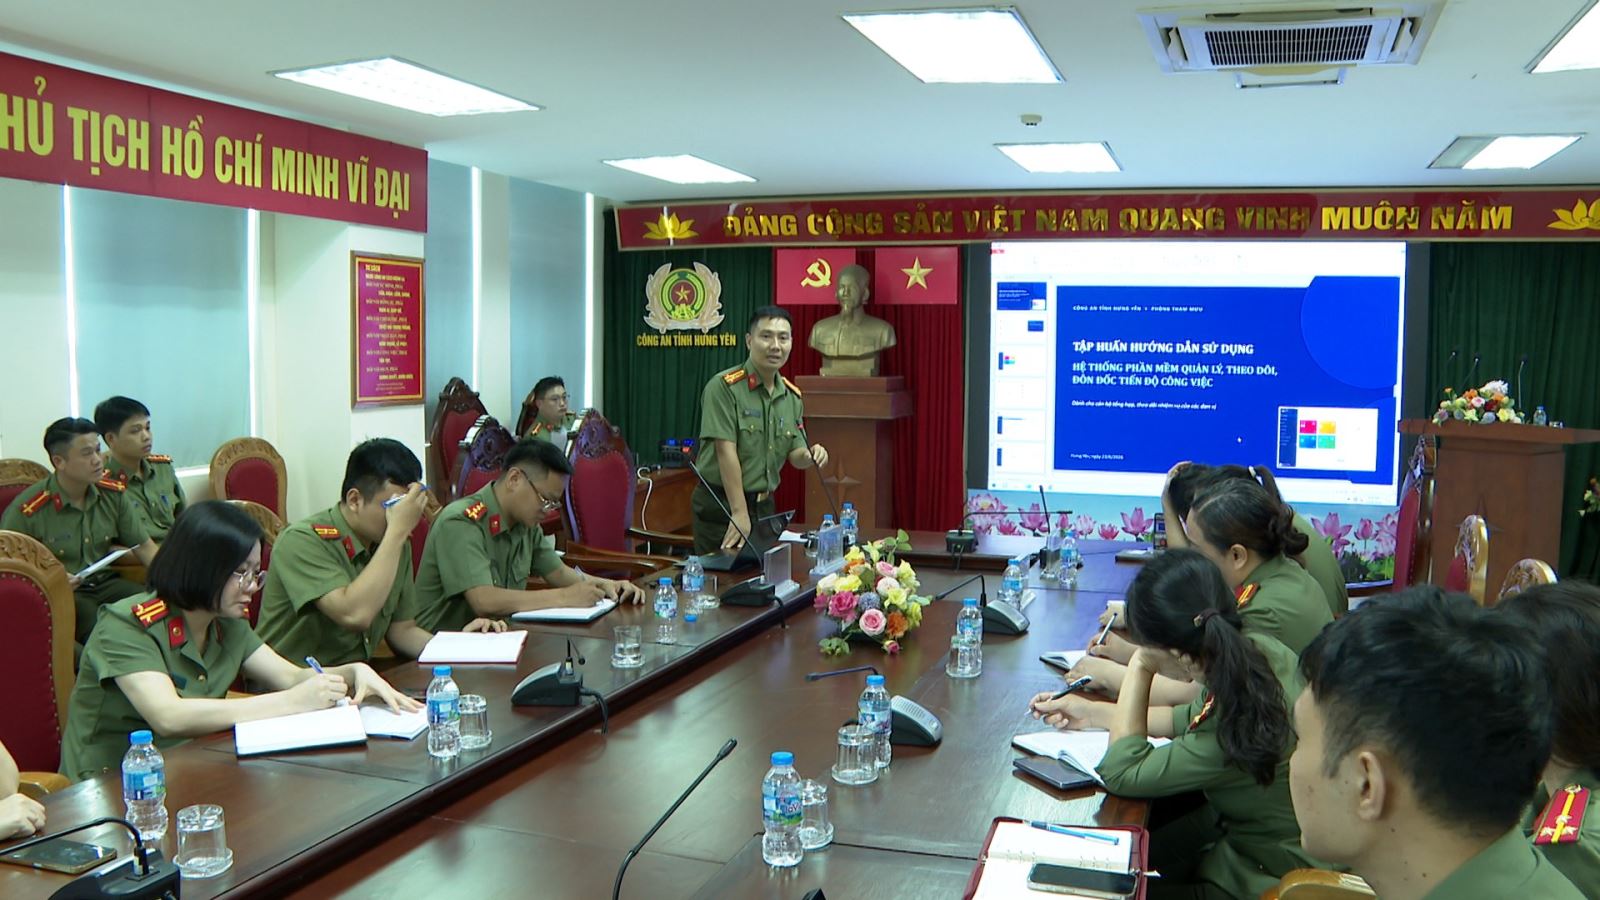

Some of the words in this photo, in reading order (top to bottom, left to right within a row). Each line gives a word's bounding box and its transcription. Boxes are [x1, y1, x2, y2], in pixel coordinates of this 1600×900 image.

[67, 106, 150, 176] TỊCH
[161, 115, 204, 180] HỒ
[214, 133, 263, 188] CHÍ
[272, 147, 339, 200] MINH
[346, 155, 369, 204] VĨ
[374, 171, 410, 219] ĐẠI
[723, 206, 799, 237] ĐẢNG
[807, 207, 884, 240] CỘNG
[892, 203, 954, 233] SẢN
[962, 204, 1026, 236] VIỆT
[1035, 208, 1108, 232] NAM
[1119, 207, 1225, 233] QUANG
[1236, 207, 1312, 231] VINH
[1321, 200, 1420, 231] MUÔN
[1430, 199, 1513, 231] NĂM
[636, 332, 659, 347] CÔNG
[660, 334, 672, 347] AN
[673, 331, 693, 347] TỈNH
[719, 332, 737, 346] YÊN
[1072, 339, 1094, 354] TẬP
[1096, 339, 1128, 353] HUẤN
[1130, 340, 1174, 353] HƯỚNG
[1176, 340, 1200, 354] DẪN
[1202, 341, 1219, 354] SỬ
[1221, 343, 1254, 356] DỤNG
[1072, 361, 1086, 374] HỆ
[1088, 360, 1123, 372] THỐNG
[1125, 360, 1153, 373] PHẦN
[1226, 364, 1254, 375] THEO
[1160, 375, 1188, 387] CÔNG
[1190, 375, 1214, 389] VIỆC
